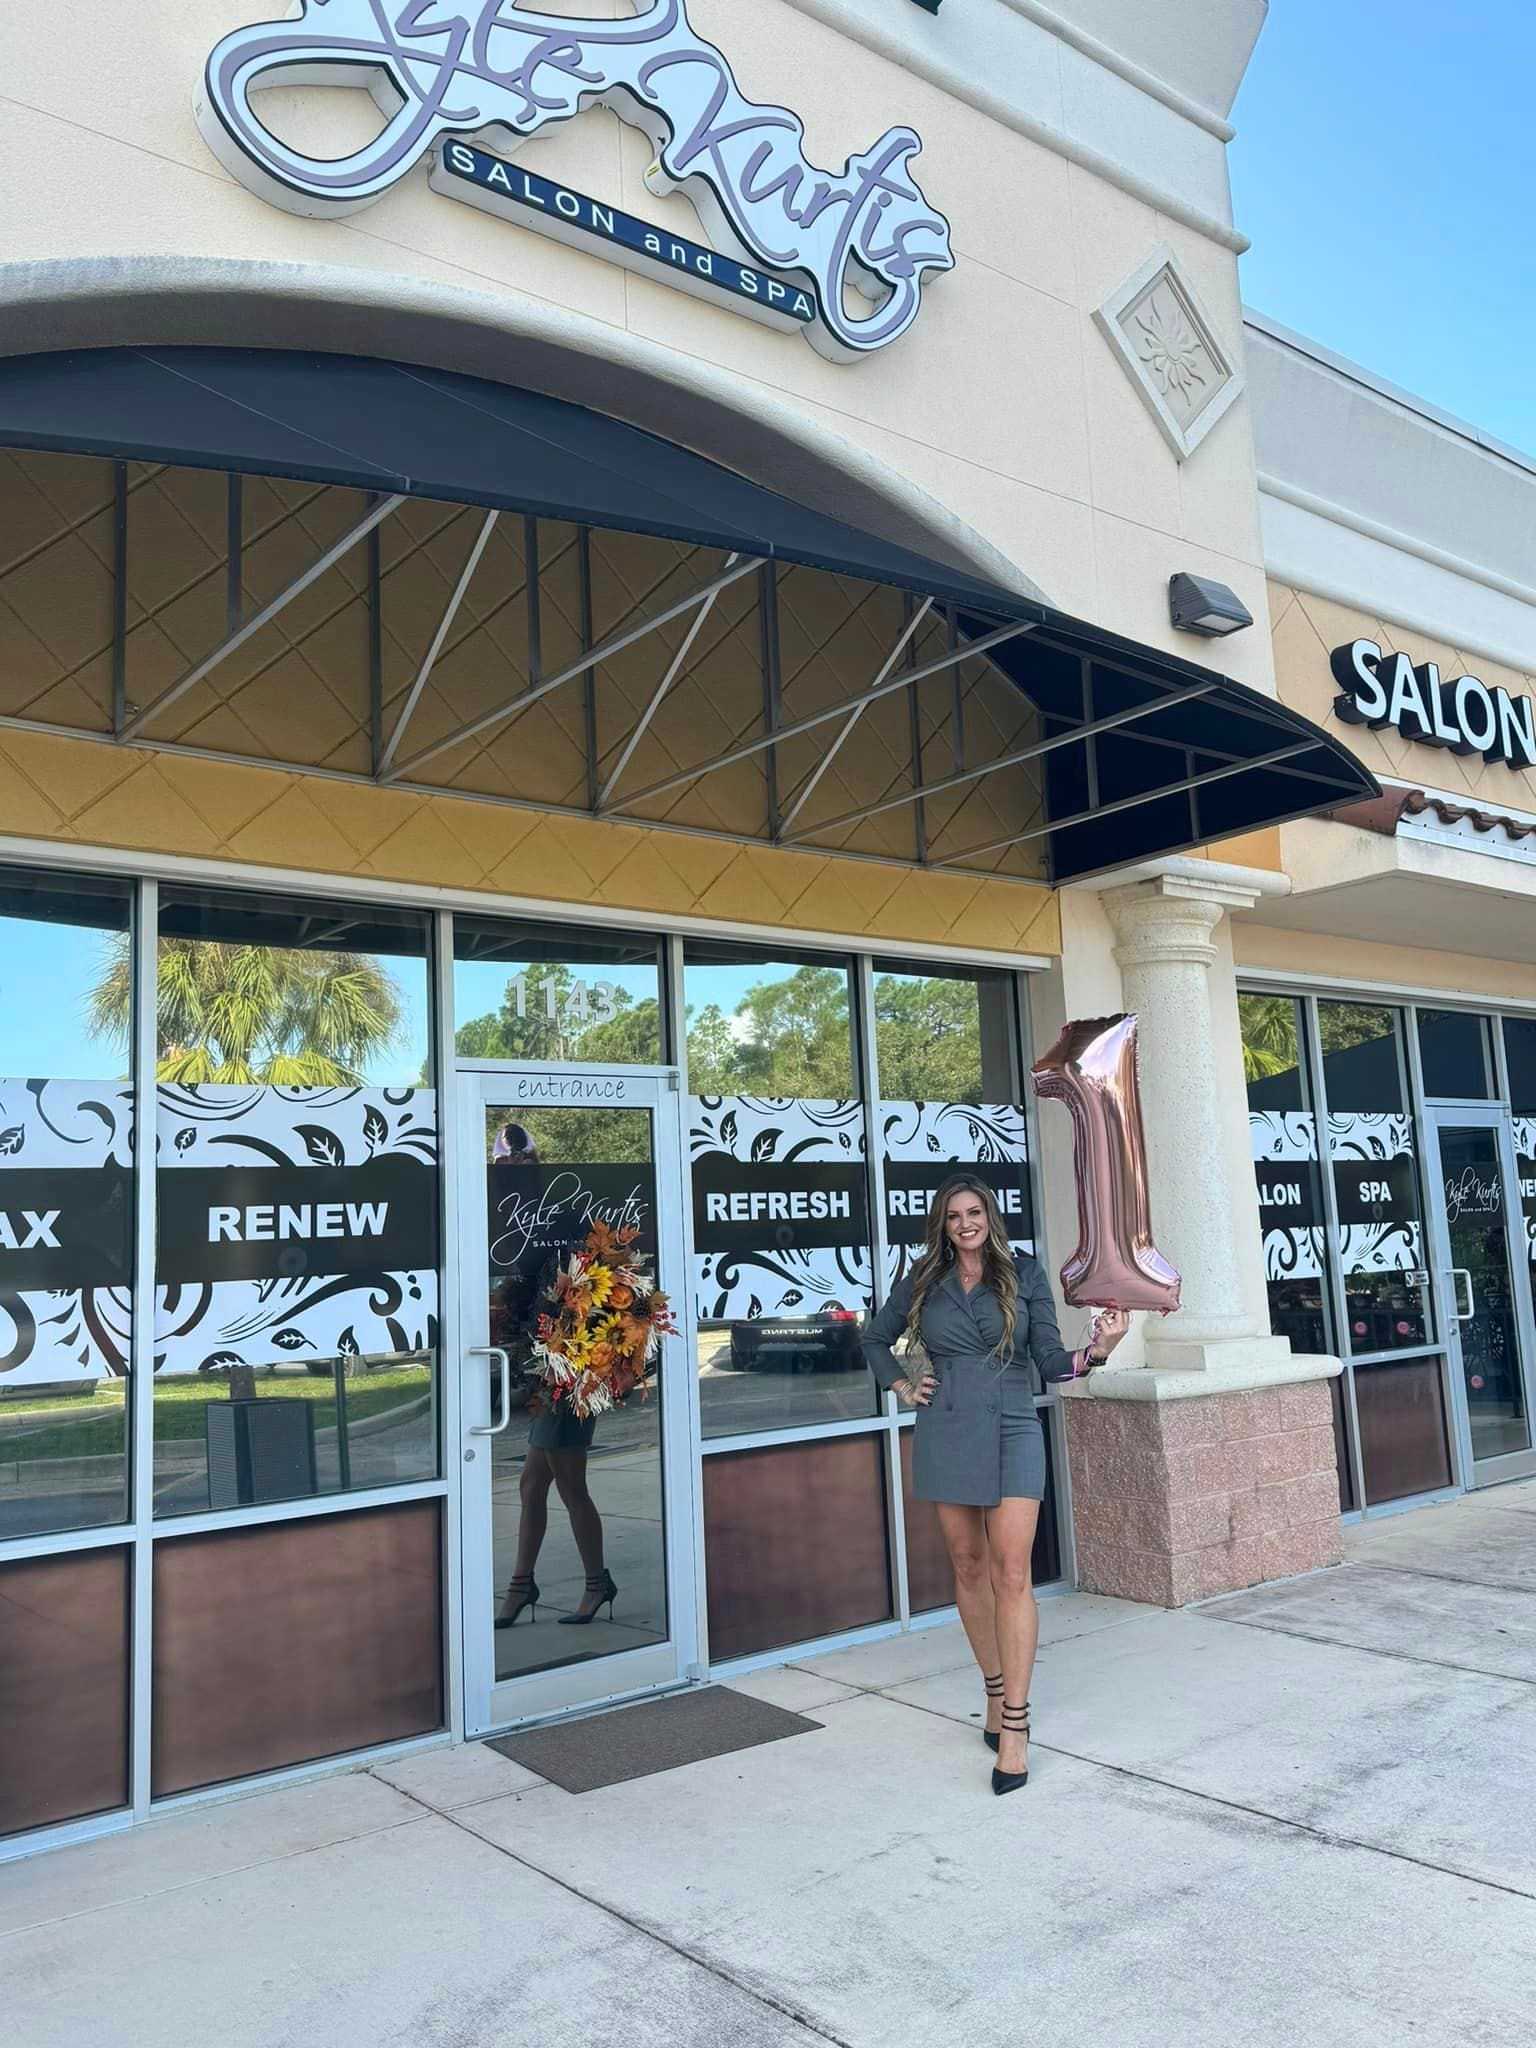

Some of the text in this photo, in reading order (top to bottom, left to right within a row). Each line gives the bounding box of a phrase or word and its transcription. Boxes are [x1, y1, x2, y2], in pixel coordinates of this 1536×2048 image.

[638, 50, 950, 344] Kurtis
[449, 143, 814, 318] SALON and SPA
[1350, 637, 1536, 766] SALON
[506, 973, 617, 1024] 1143
[518, 1075, 626, 1099] entrance
[706, 1190, 851, 1222] REFRESH
[1359, 1180, 1393, 1203] SPA
[207, 1202, 389, 1242] RENEW
[490, 1172, 649, 1266] Kyle Kurtis
[532, 1239, 568, 1248] SALON
